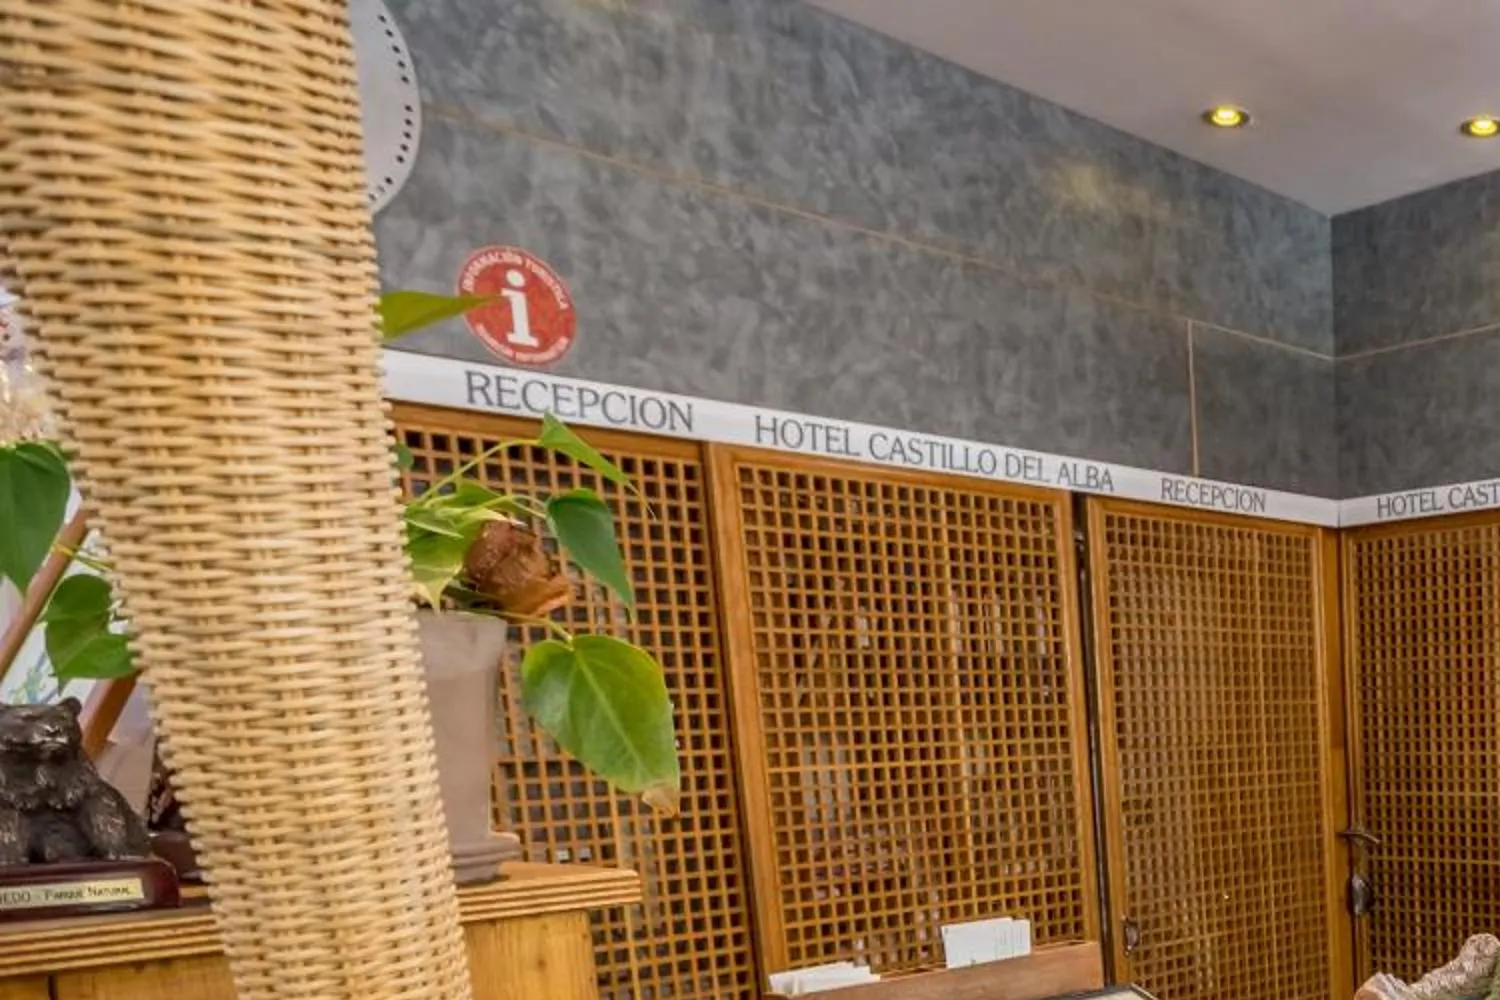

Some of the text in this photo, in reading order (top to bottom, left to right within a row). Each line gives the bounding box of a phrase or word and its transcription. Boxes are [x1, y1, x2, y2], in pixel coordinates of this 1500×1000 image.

[464, 370, 695, 433] RECEPCION
[755, 415, 1114, 492] HOTEL CASTILLO DEL ALBA
[1160, 477, 1266, 513] RECEPCION
[1376, 490, 1443, 518] HOTEL
